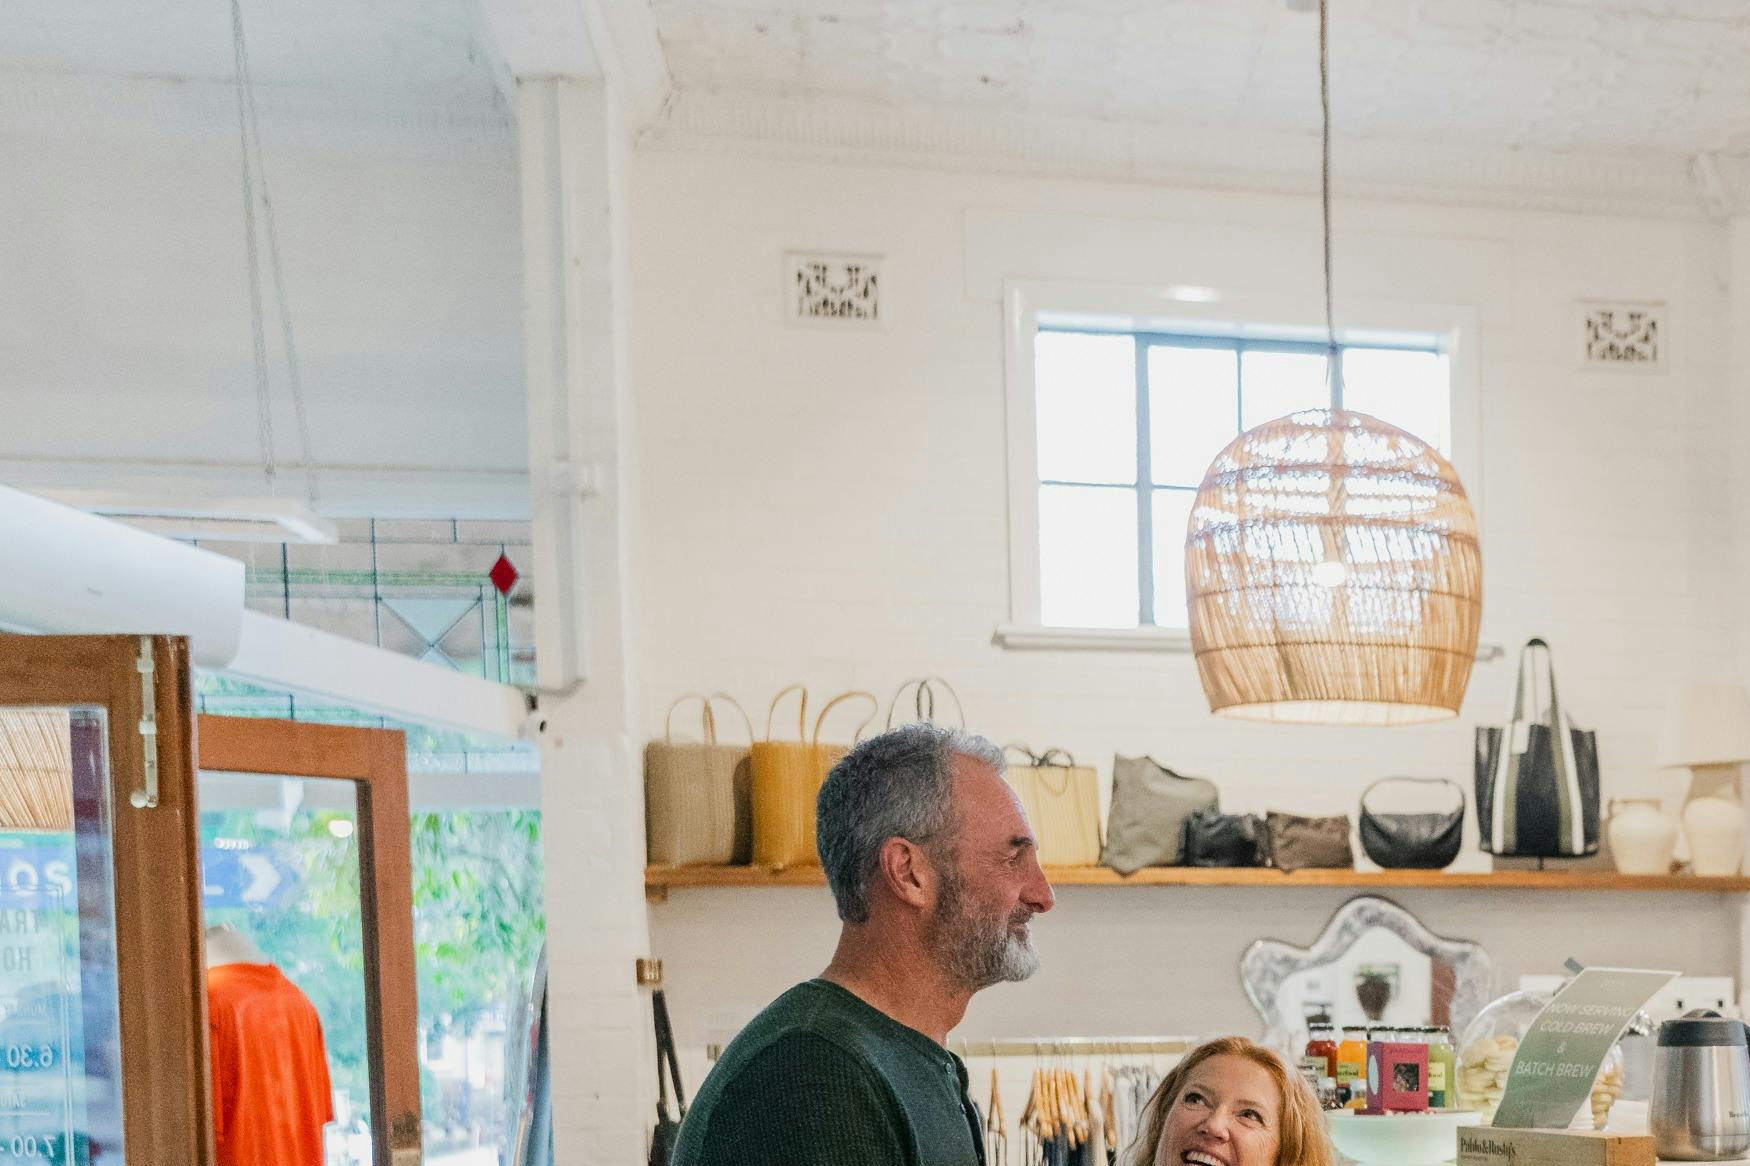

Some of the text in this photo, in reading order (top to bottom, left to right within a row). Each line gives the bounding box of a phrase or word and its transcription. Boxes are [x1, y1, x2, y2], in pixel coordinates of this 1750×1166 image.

[1546, 1003, 1636, 1017] NOW SERVING
[1540, 1021, 1614, 1034] COLD BREW
[1557, 1041, 1568, 1054] &
[1515, 1061, 1594, 1078] BATCH BREW
